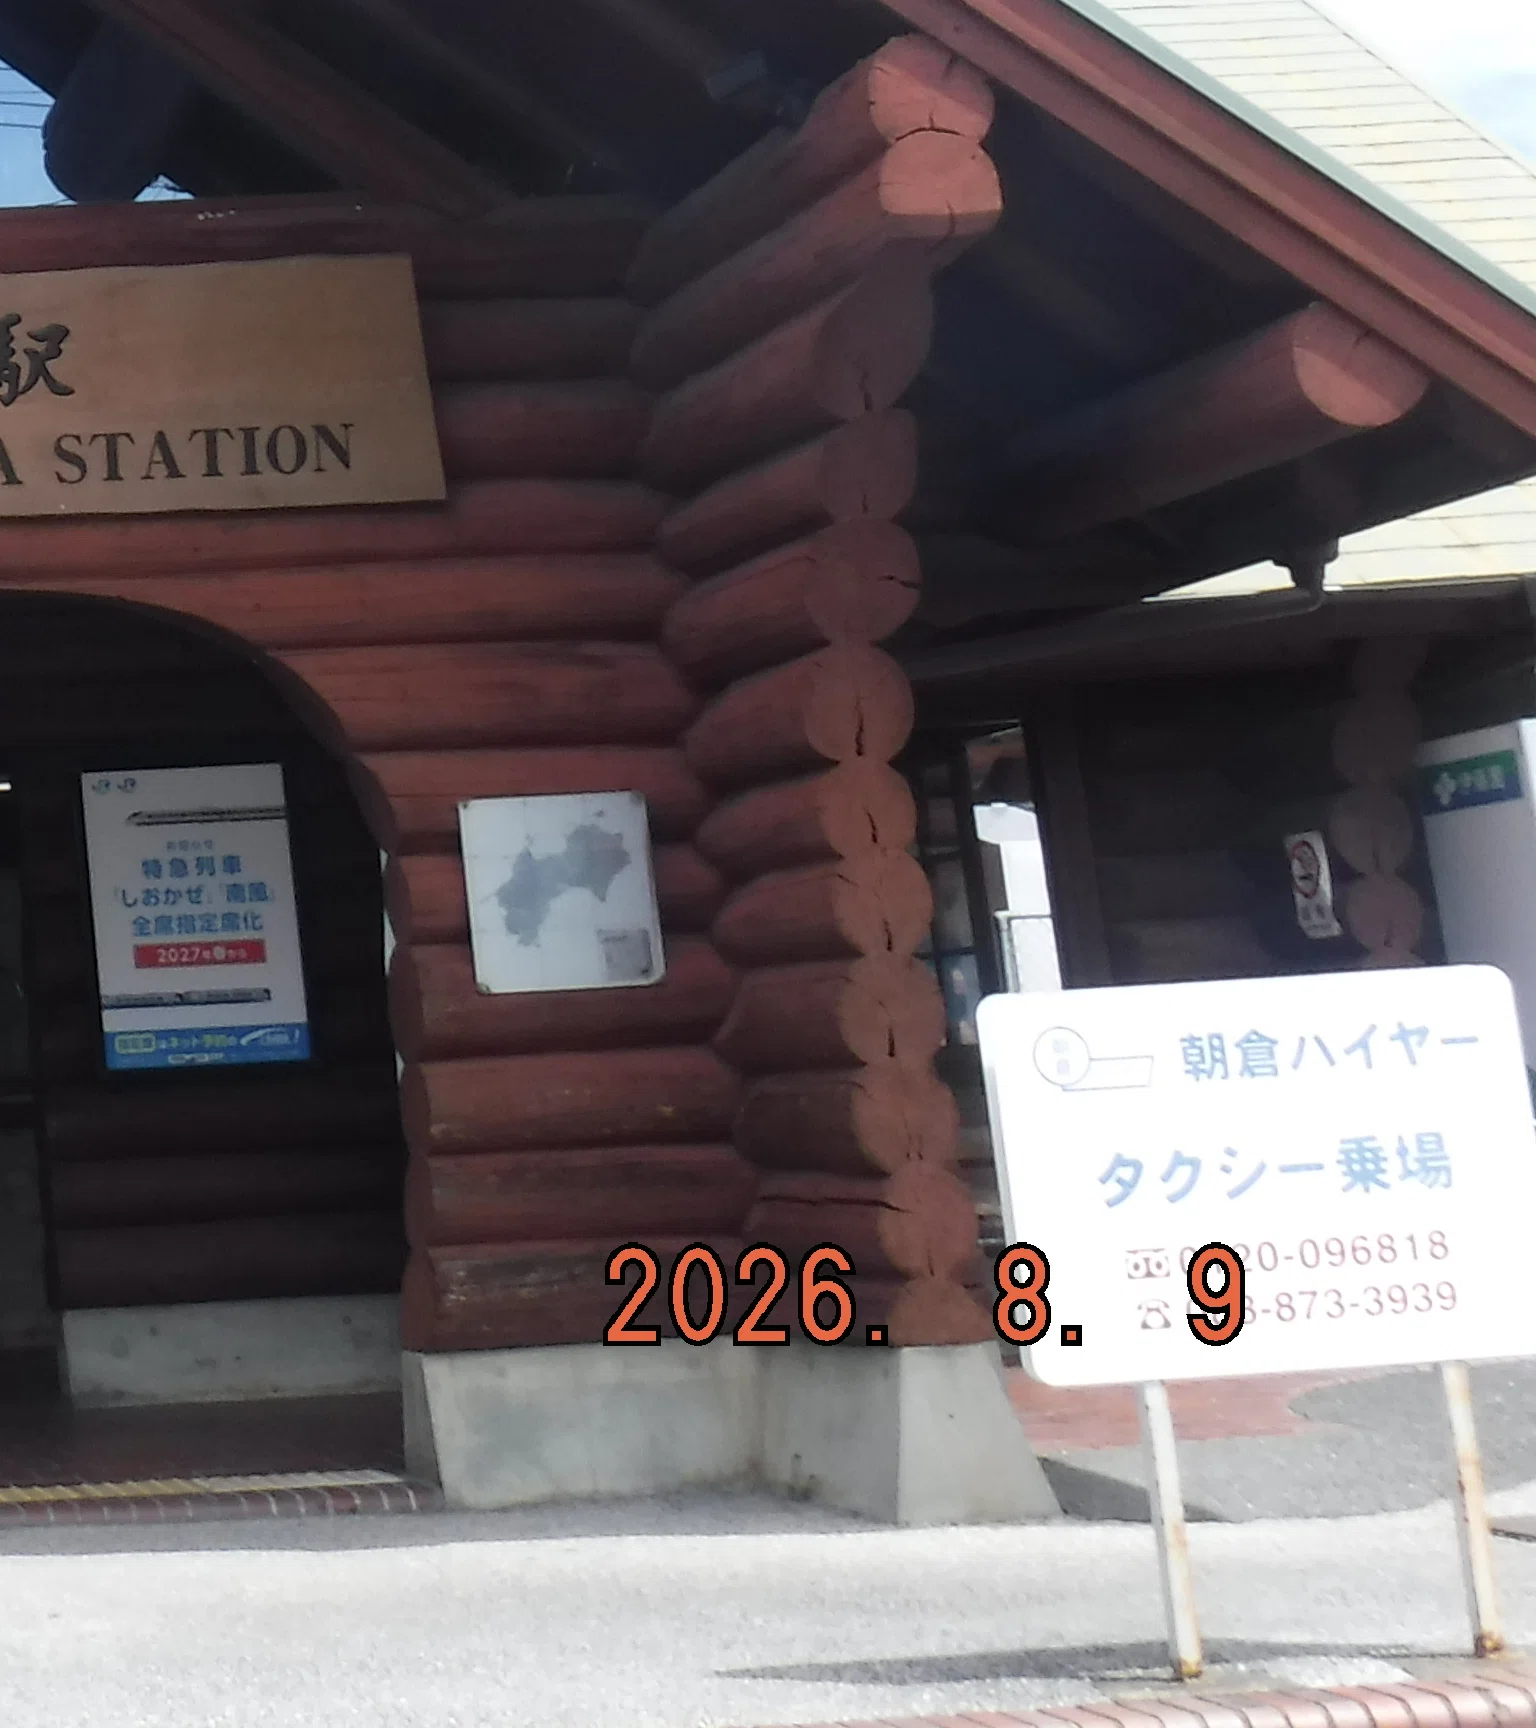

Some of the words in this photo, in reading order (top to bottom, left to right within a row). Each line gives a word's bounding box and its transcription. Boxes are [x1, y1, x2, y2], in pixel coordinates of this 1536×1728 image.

[53, 422, 356, 485] STATION
[1178, 1021, 1480, 1083] 朝倉ハイヤー
[1096, 1130, 1455, 1209] タクシー乗場
